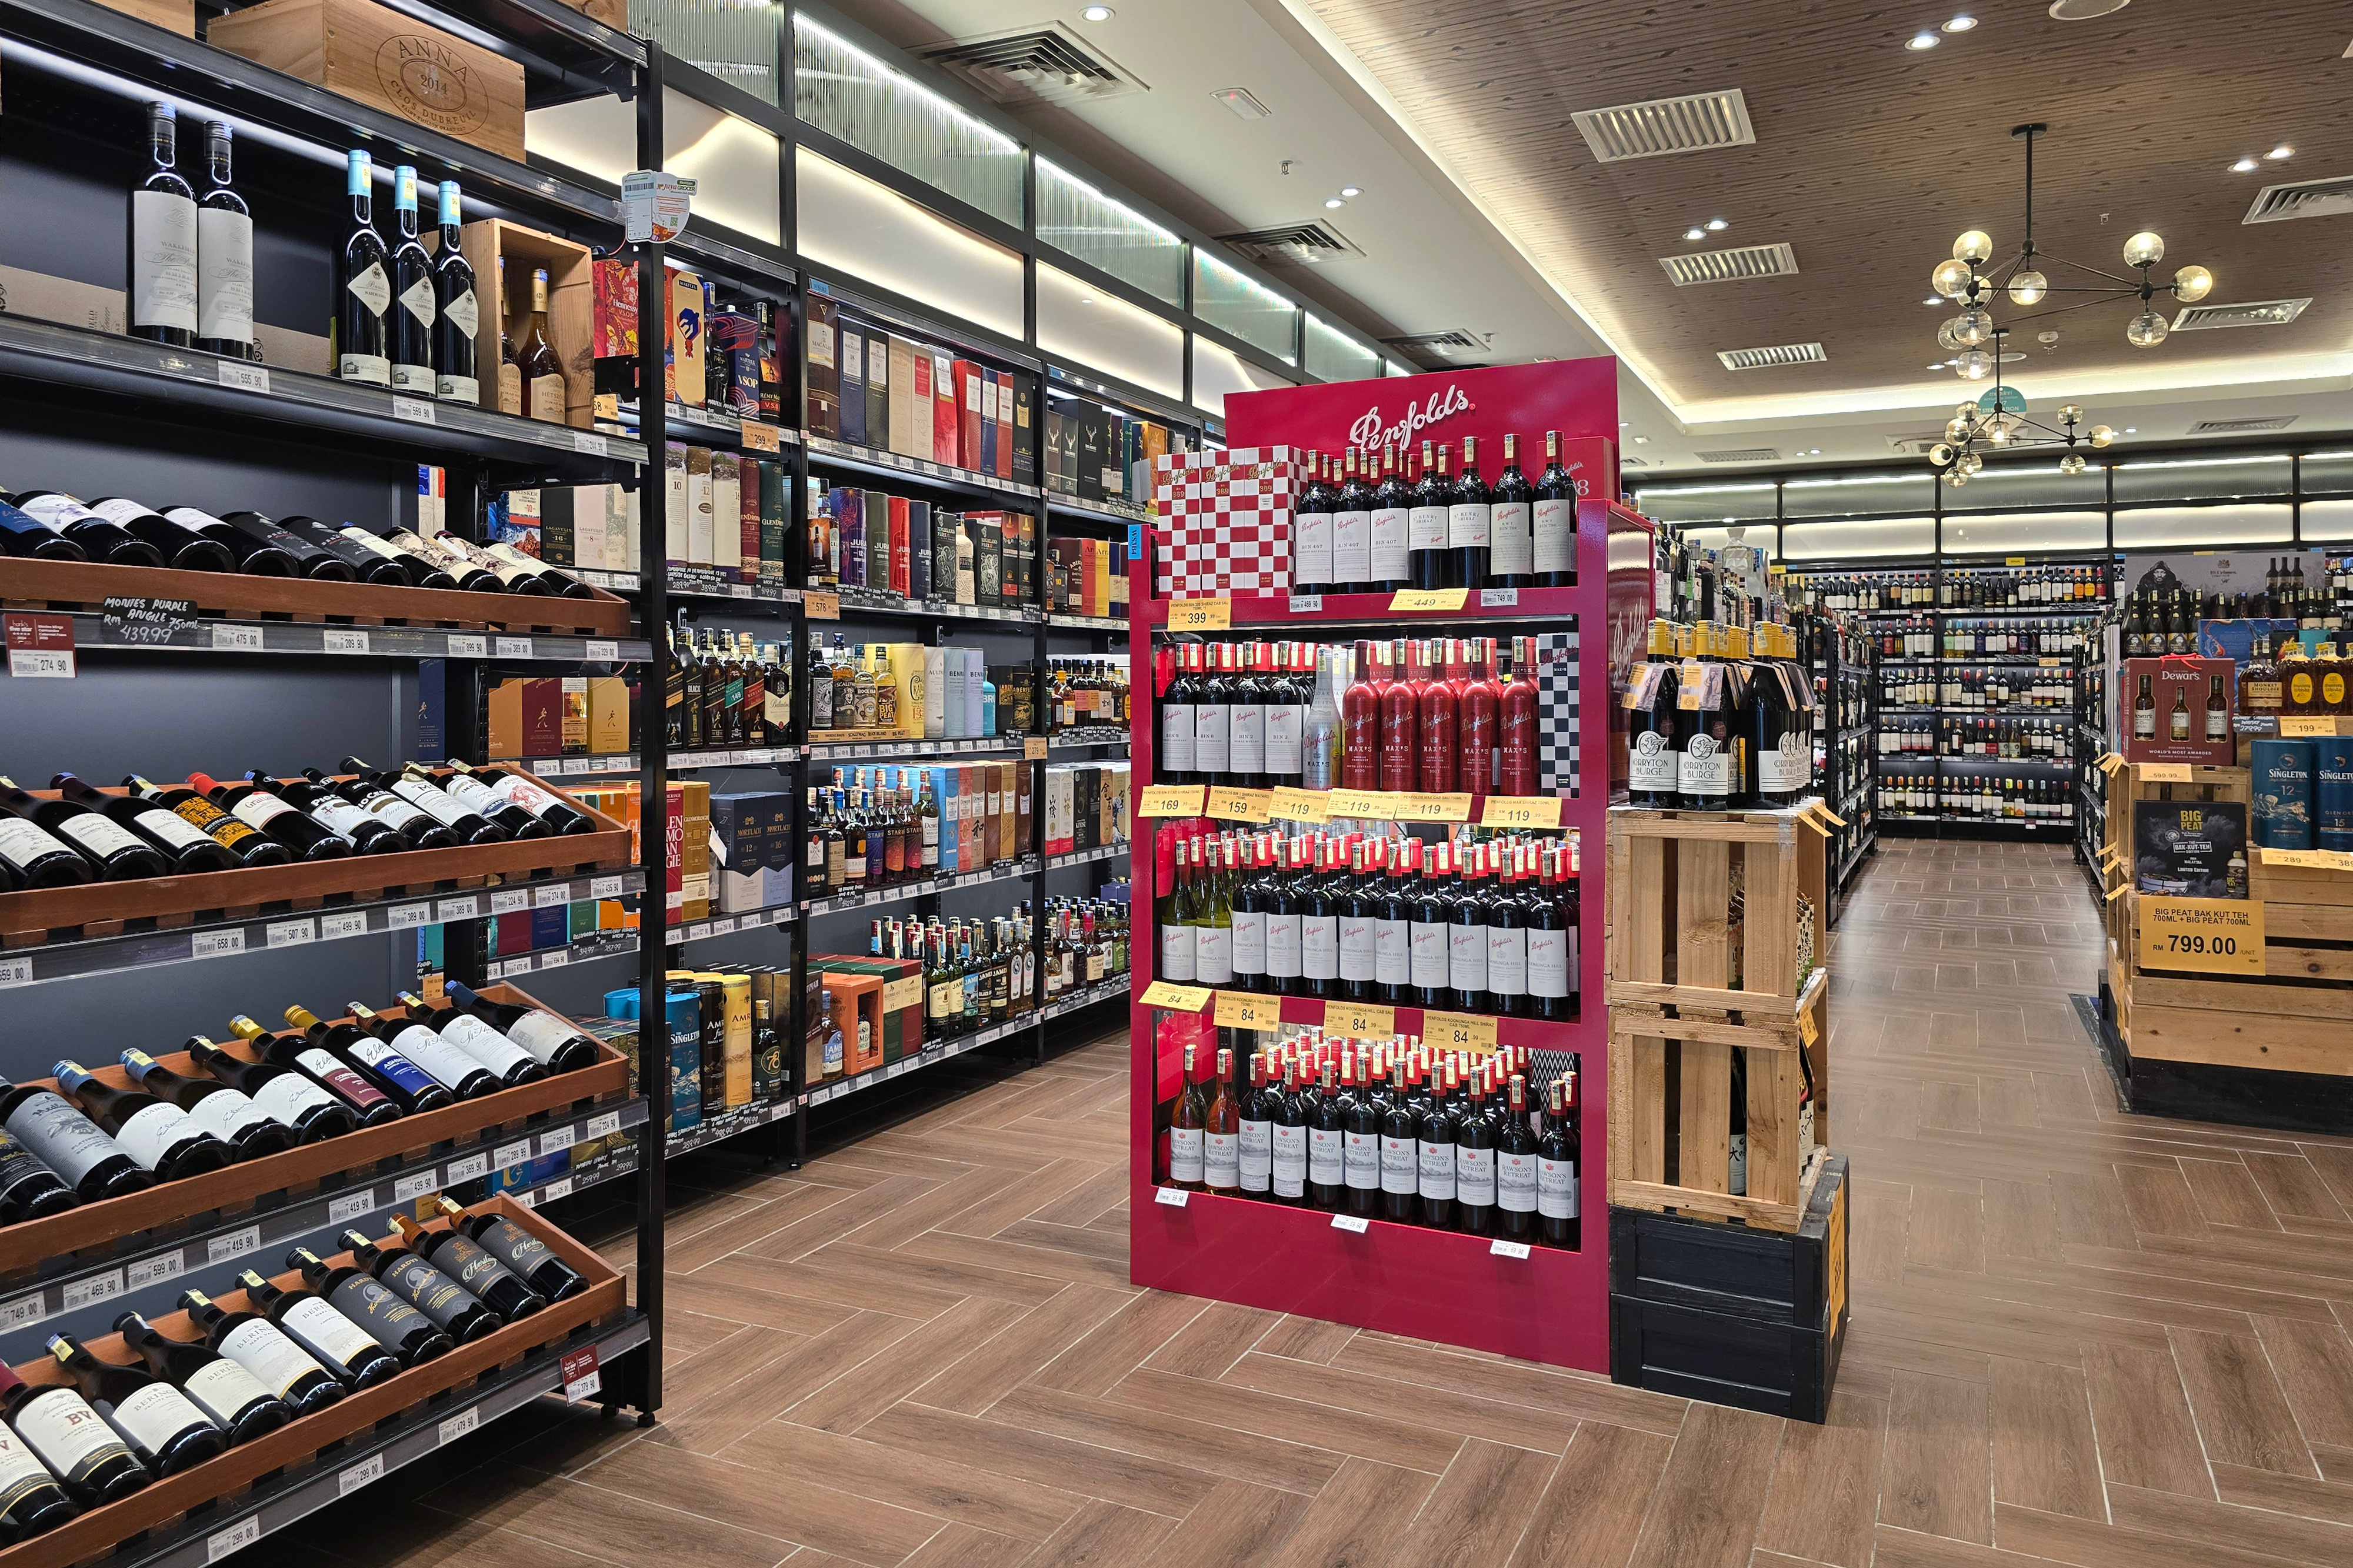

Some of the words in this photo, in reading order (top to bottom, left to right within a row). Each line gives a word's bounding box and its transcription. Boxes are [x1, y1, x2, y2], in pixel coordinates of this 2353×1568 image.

[399, 38, 466, 84] ANNA
[421, 75, 448, 95] 2014
[391, 81, 417, 110] CLOS
[422, 109, 476, 125] DUBREUIL
[679, 279, 697, 290] MARTELL
[613, 298, 638, 313] Hennessy
[812, 340, 832, 351] MACALLAN
[739, 356, 756, 366] MARTELL
[738, 374, 758, 389] VSOP
[1349, 384, 1469, 453] Penfolds
[754, 434, 765, 444] 299
[1161, 465, 1196, 486] Penfolds
[1205, 461, 1241, 483] Penfolds
[674, 481, 682, 491] 10
[702, 486, 709, 495] 12
[526, 504, 532, 512] 10
[1497, 507, 1520, 521] Penfolds
[1301, 519, 1322, 532] Penfolds
[1338, 517, 1358, 530] Penfolds
[105, 598, 146, 608] MONTES
[152, 599, 188, 612] PURPLE
[816, 603, 826, 612] 578
[1188, 612, 1206, 623] 399
[1613, 596, 1645, 689] Penfolds
[1541, 645, 1578, 666] Penfolds
[2162, 671, 2200, 680] Dewar's
[688, 685, 701, 693] BLACK
[731, 692, 741, 700] 149
[879, 705, 893, 713] BIG
[1235, 709, 1257, 722] Penfolds
[1382, 710, 1414, 729] Penfolds
[1304, 730, 1337, 750] Penfolds
[1635, 767, 1663, 775] BURGE
[1687, 770, 1715, 779] BURGE
[2269, 769, 2308, 779] SINGLETON
[2281, 785, 2294, 795] 12
[488, 799, 502, 810] GRAN
[1161, 800, 1178, 810] 169
[1229, 801, 1247, 813] 159
[1291, 803, 1309, 815] 119
[1350, 802, 1369, 812] 119
[1420, 804, 1441, 814] 119
[1508, 810, 1529, 821] 119
[2180, 810, 2201, 822] BIG
[766, 824, 791, 833] MORTLACH
[2181, 822, 2203, 830] PEAT
[2334, 819, 2345, 827] 15
[737, 827, 762, 836] MORTLACH
[745, 844, 752, 852] 12
[775, 840, 782, 849] 16
[217, 936, 239, 949] 658.00
[1415, 932, 1436, 943] Penfolds
[2168, 934, 2236, 955] 799.00
[1241, 1009, 1254, 1022] 84
[1353, 1019, 1366, 1031] 84
[1454, 1030, 1468, 1043] 84
[766, 1052, 781, 1070] 78
[153, 1259, 177, 1276] 599.00
[392, 1257, 419, 1277] HARDYS
[10, 1302, 38, 1322] 749.00
[65, 1408, 93, 1426] BV
[360, 1464, 379, 1481] 299.00
[232, 1526, 254, 1546] 299.00
